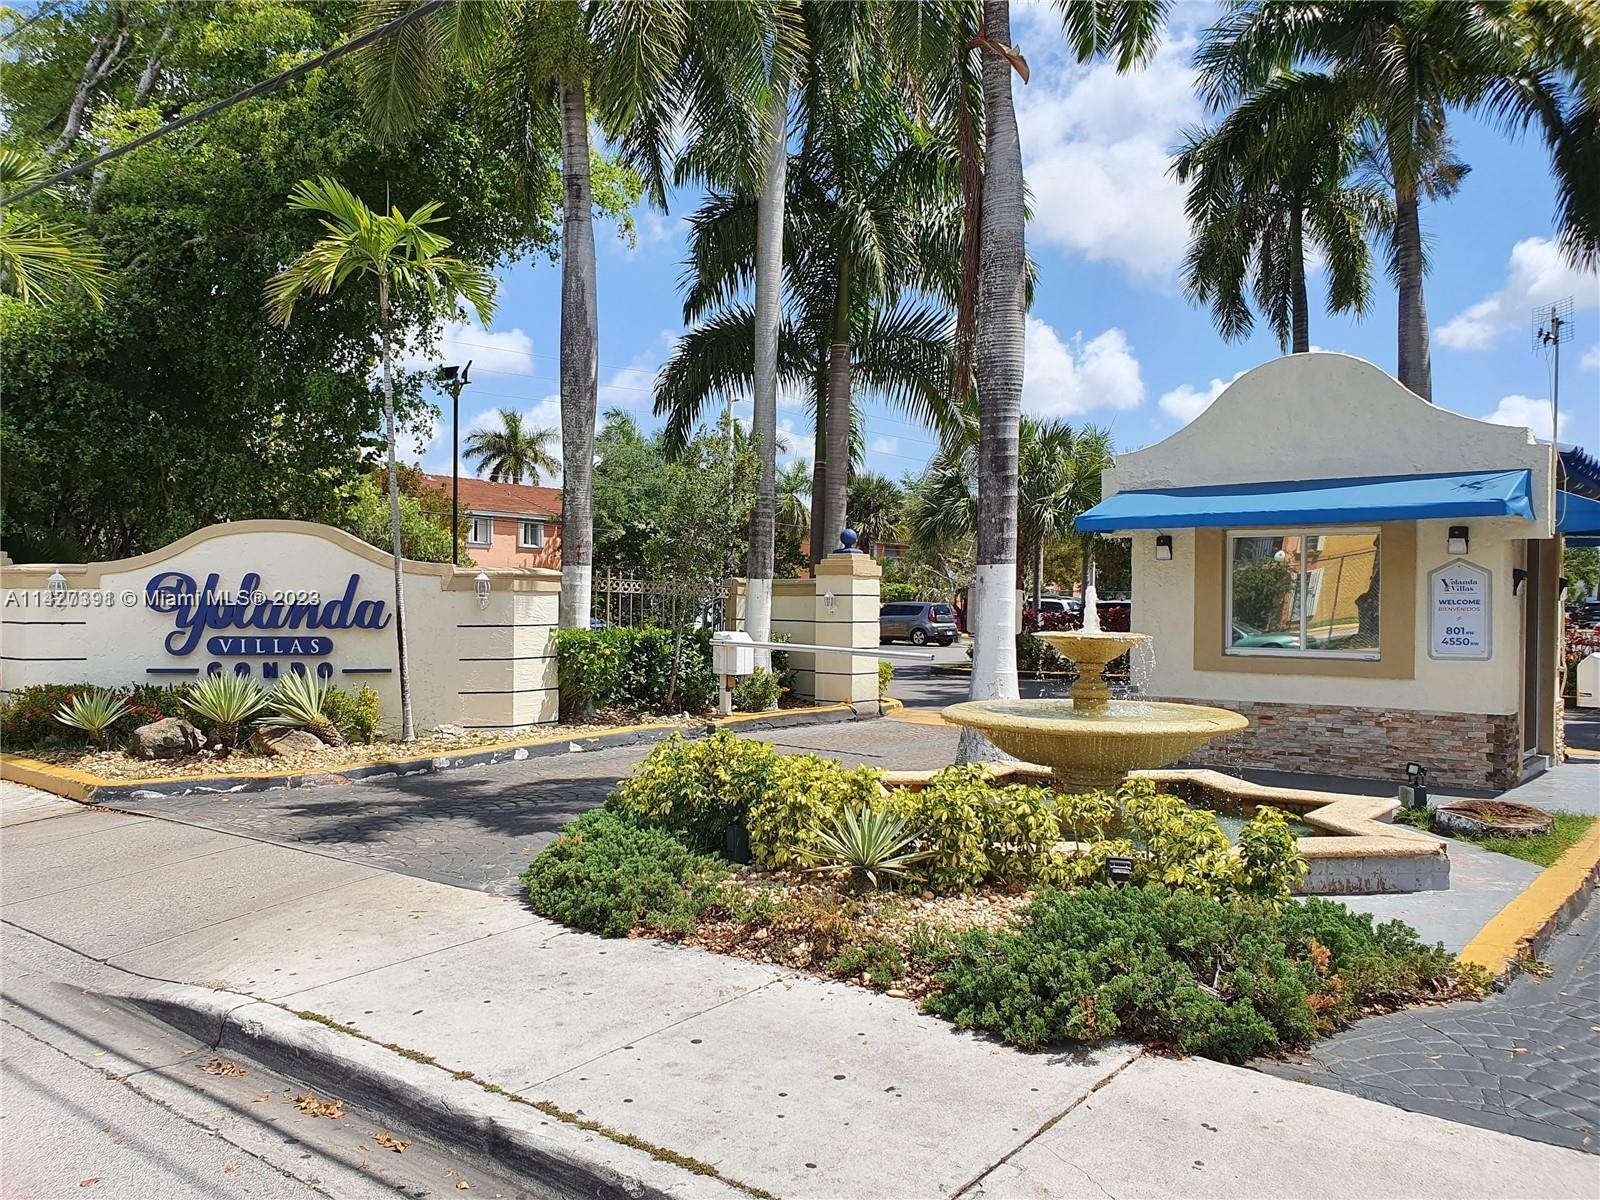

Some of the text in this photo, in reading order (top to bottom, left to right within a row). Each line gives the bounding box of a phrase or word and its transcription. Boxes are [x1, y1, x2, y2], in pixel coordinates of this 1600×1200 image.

[145, 572, 392, 656] Yolanda
[1446, 626, 1465, 635] 801
[217, 638, 321, 655] VILLAS
[1441, 637, 1470, 646] 4550
[206, 661, 334, 680] CONDO
